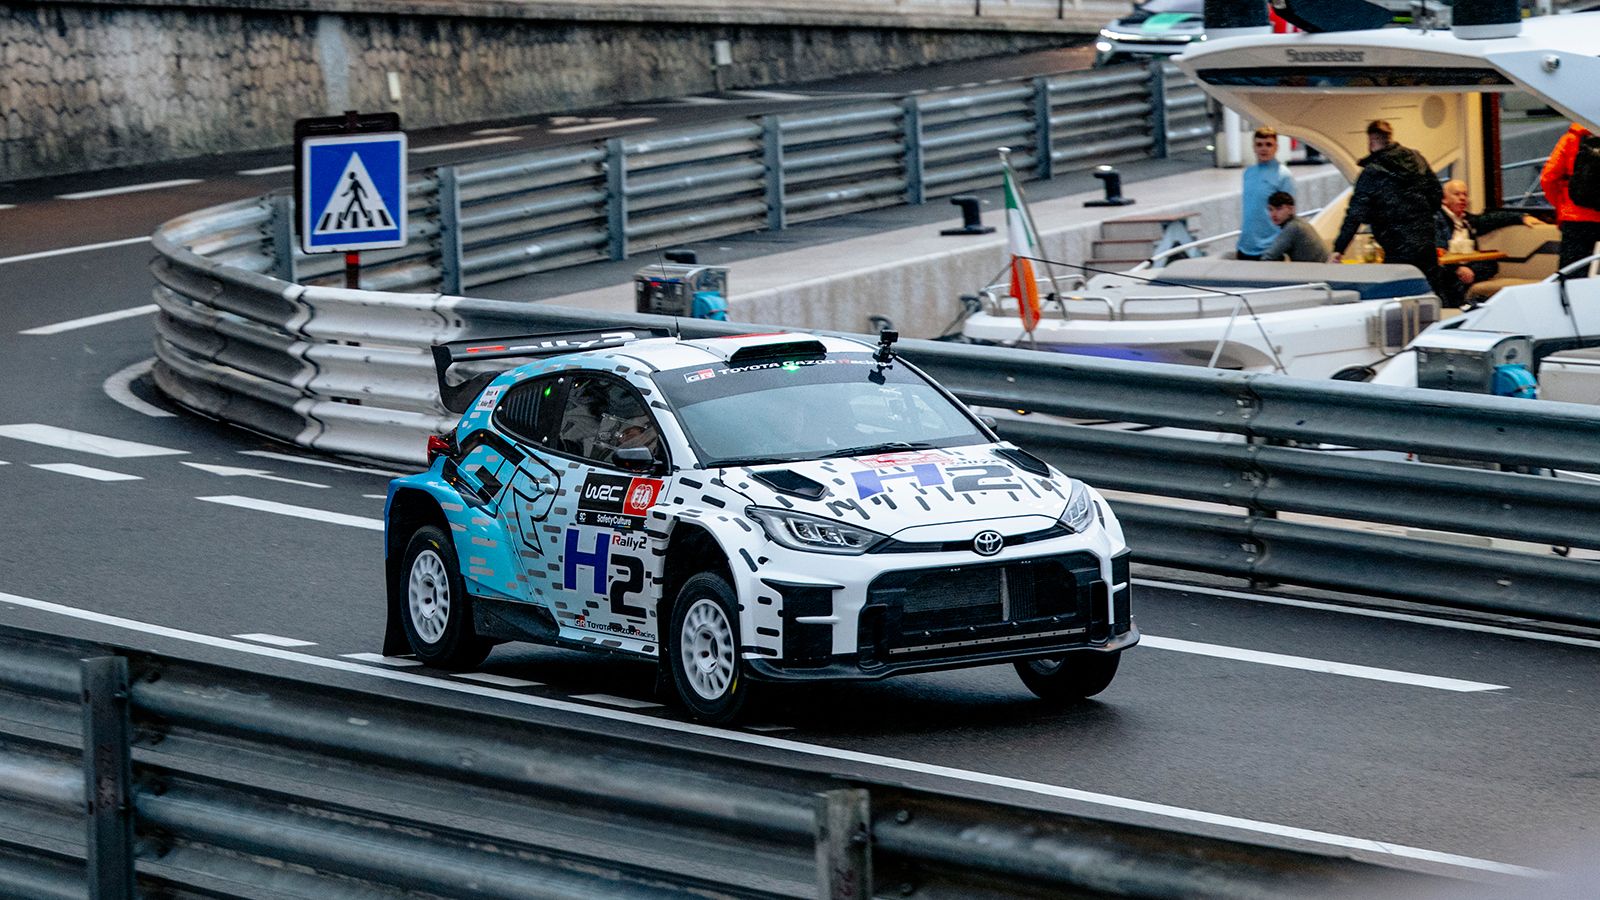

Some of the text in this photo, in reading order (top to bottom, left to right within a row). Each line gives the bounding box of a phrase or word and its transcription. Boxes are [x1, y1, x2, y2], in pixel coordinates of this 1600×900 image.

[1285, 48, 1365, 63] Sunseeker
[686, 370, 715, 383] GR
[718, 362, 780, 375] TOYOTA
[782, 359, 836, 368] GAZOO
[585, 483, 623, 502] WRC
[597, 514, 632, 527] SafetyCulture
[612, 535, 647, 551] Rally2
[563, 528, 647, 619] H2
[587, 621, 611, 632] TOYOTA
[635, 629, 655, 641] Racing
